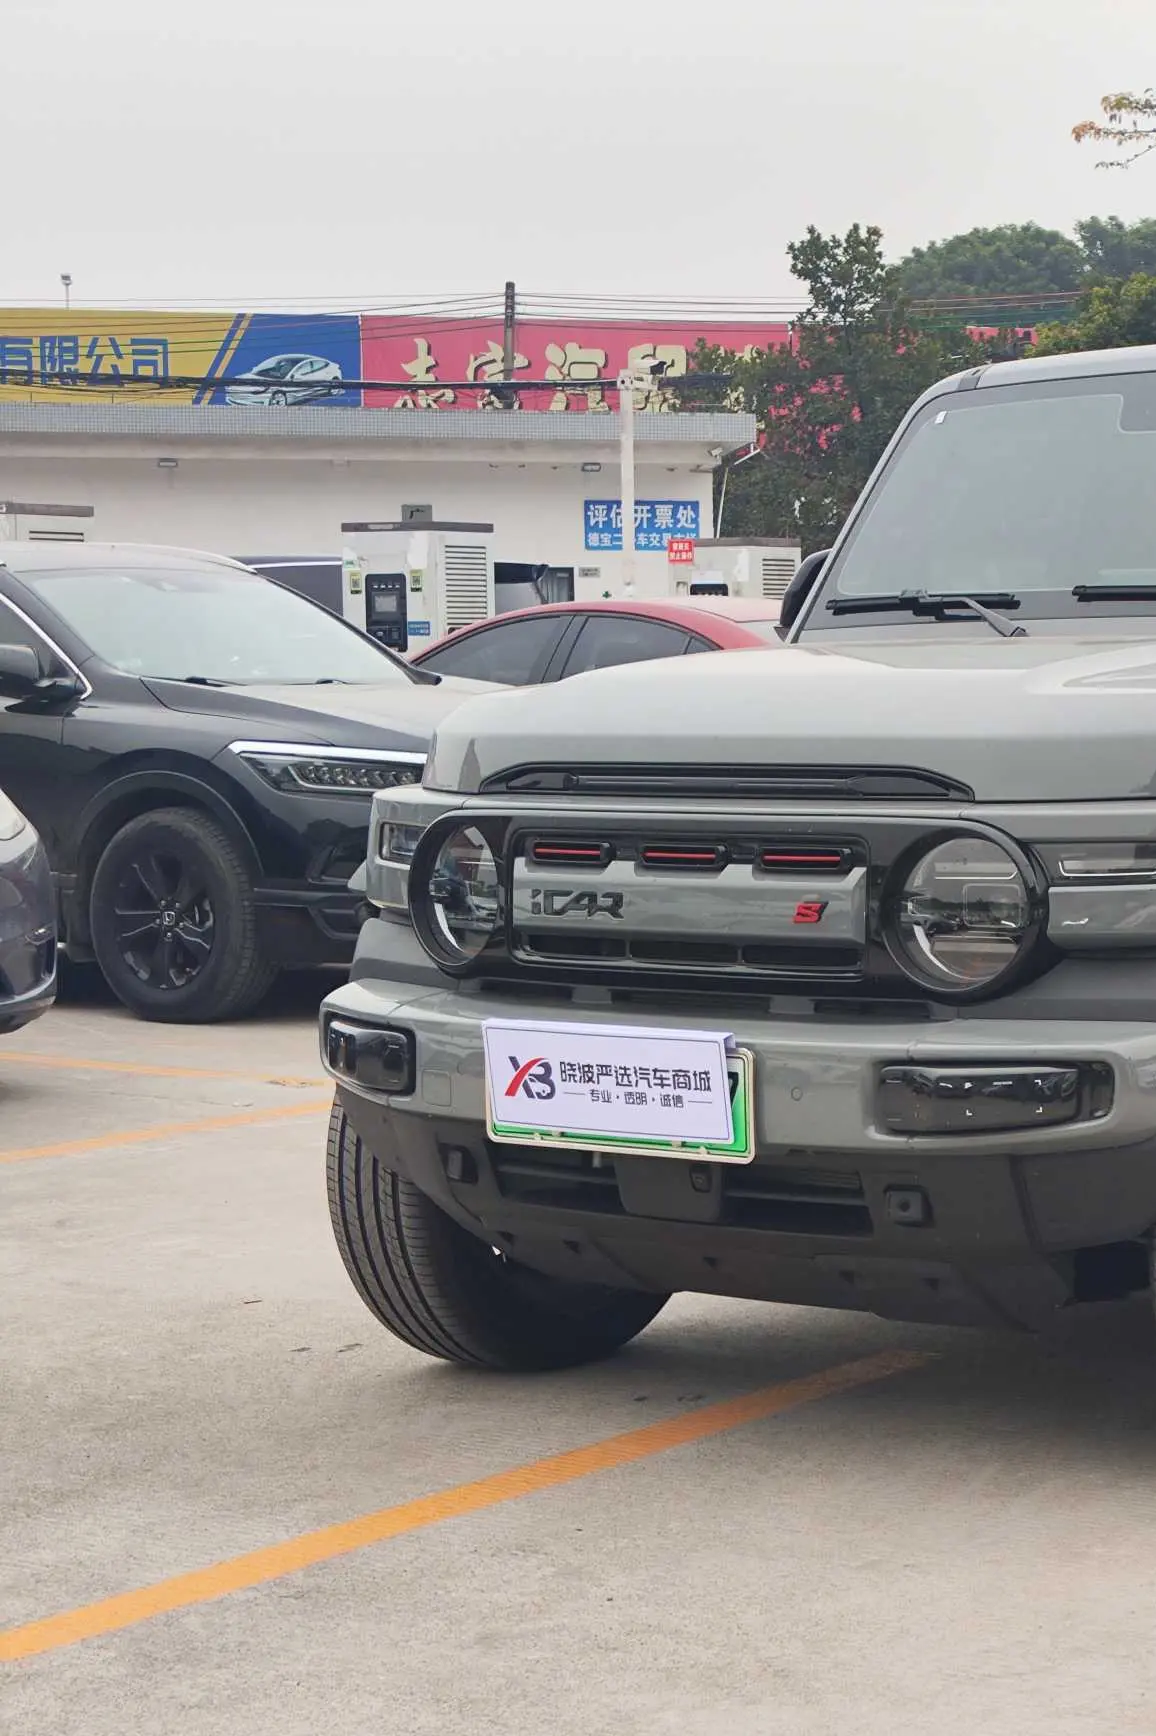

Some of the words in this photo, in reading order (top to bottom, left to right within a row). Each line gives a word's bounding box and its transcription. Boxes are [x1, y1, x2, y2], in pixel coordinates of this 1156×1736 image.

[0, 335, 169, 388] 有限公司
[588, 504, 697, 529] 评估开票处
[559, 1061, 712, 1093] 晓波严选汽车商城
